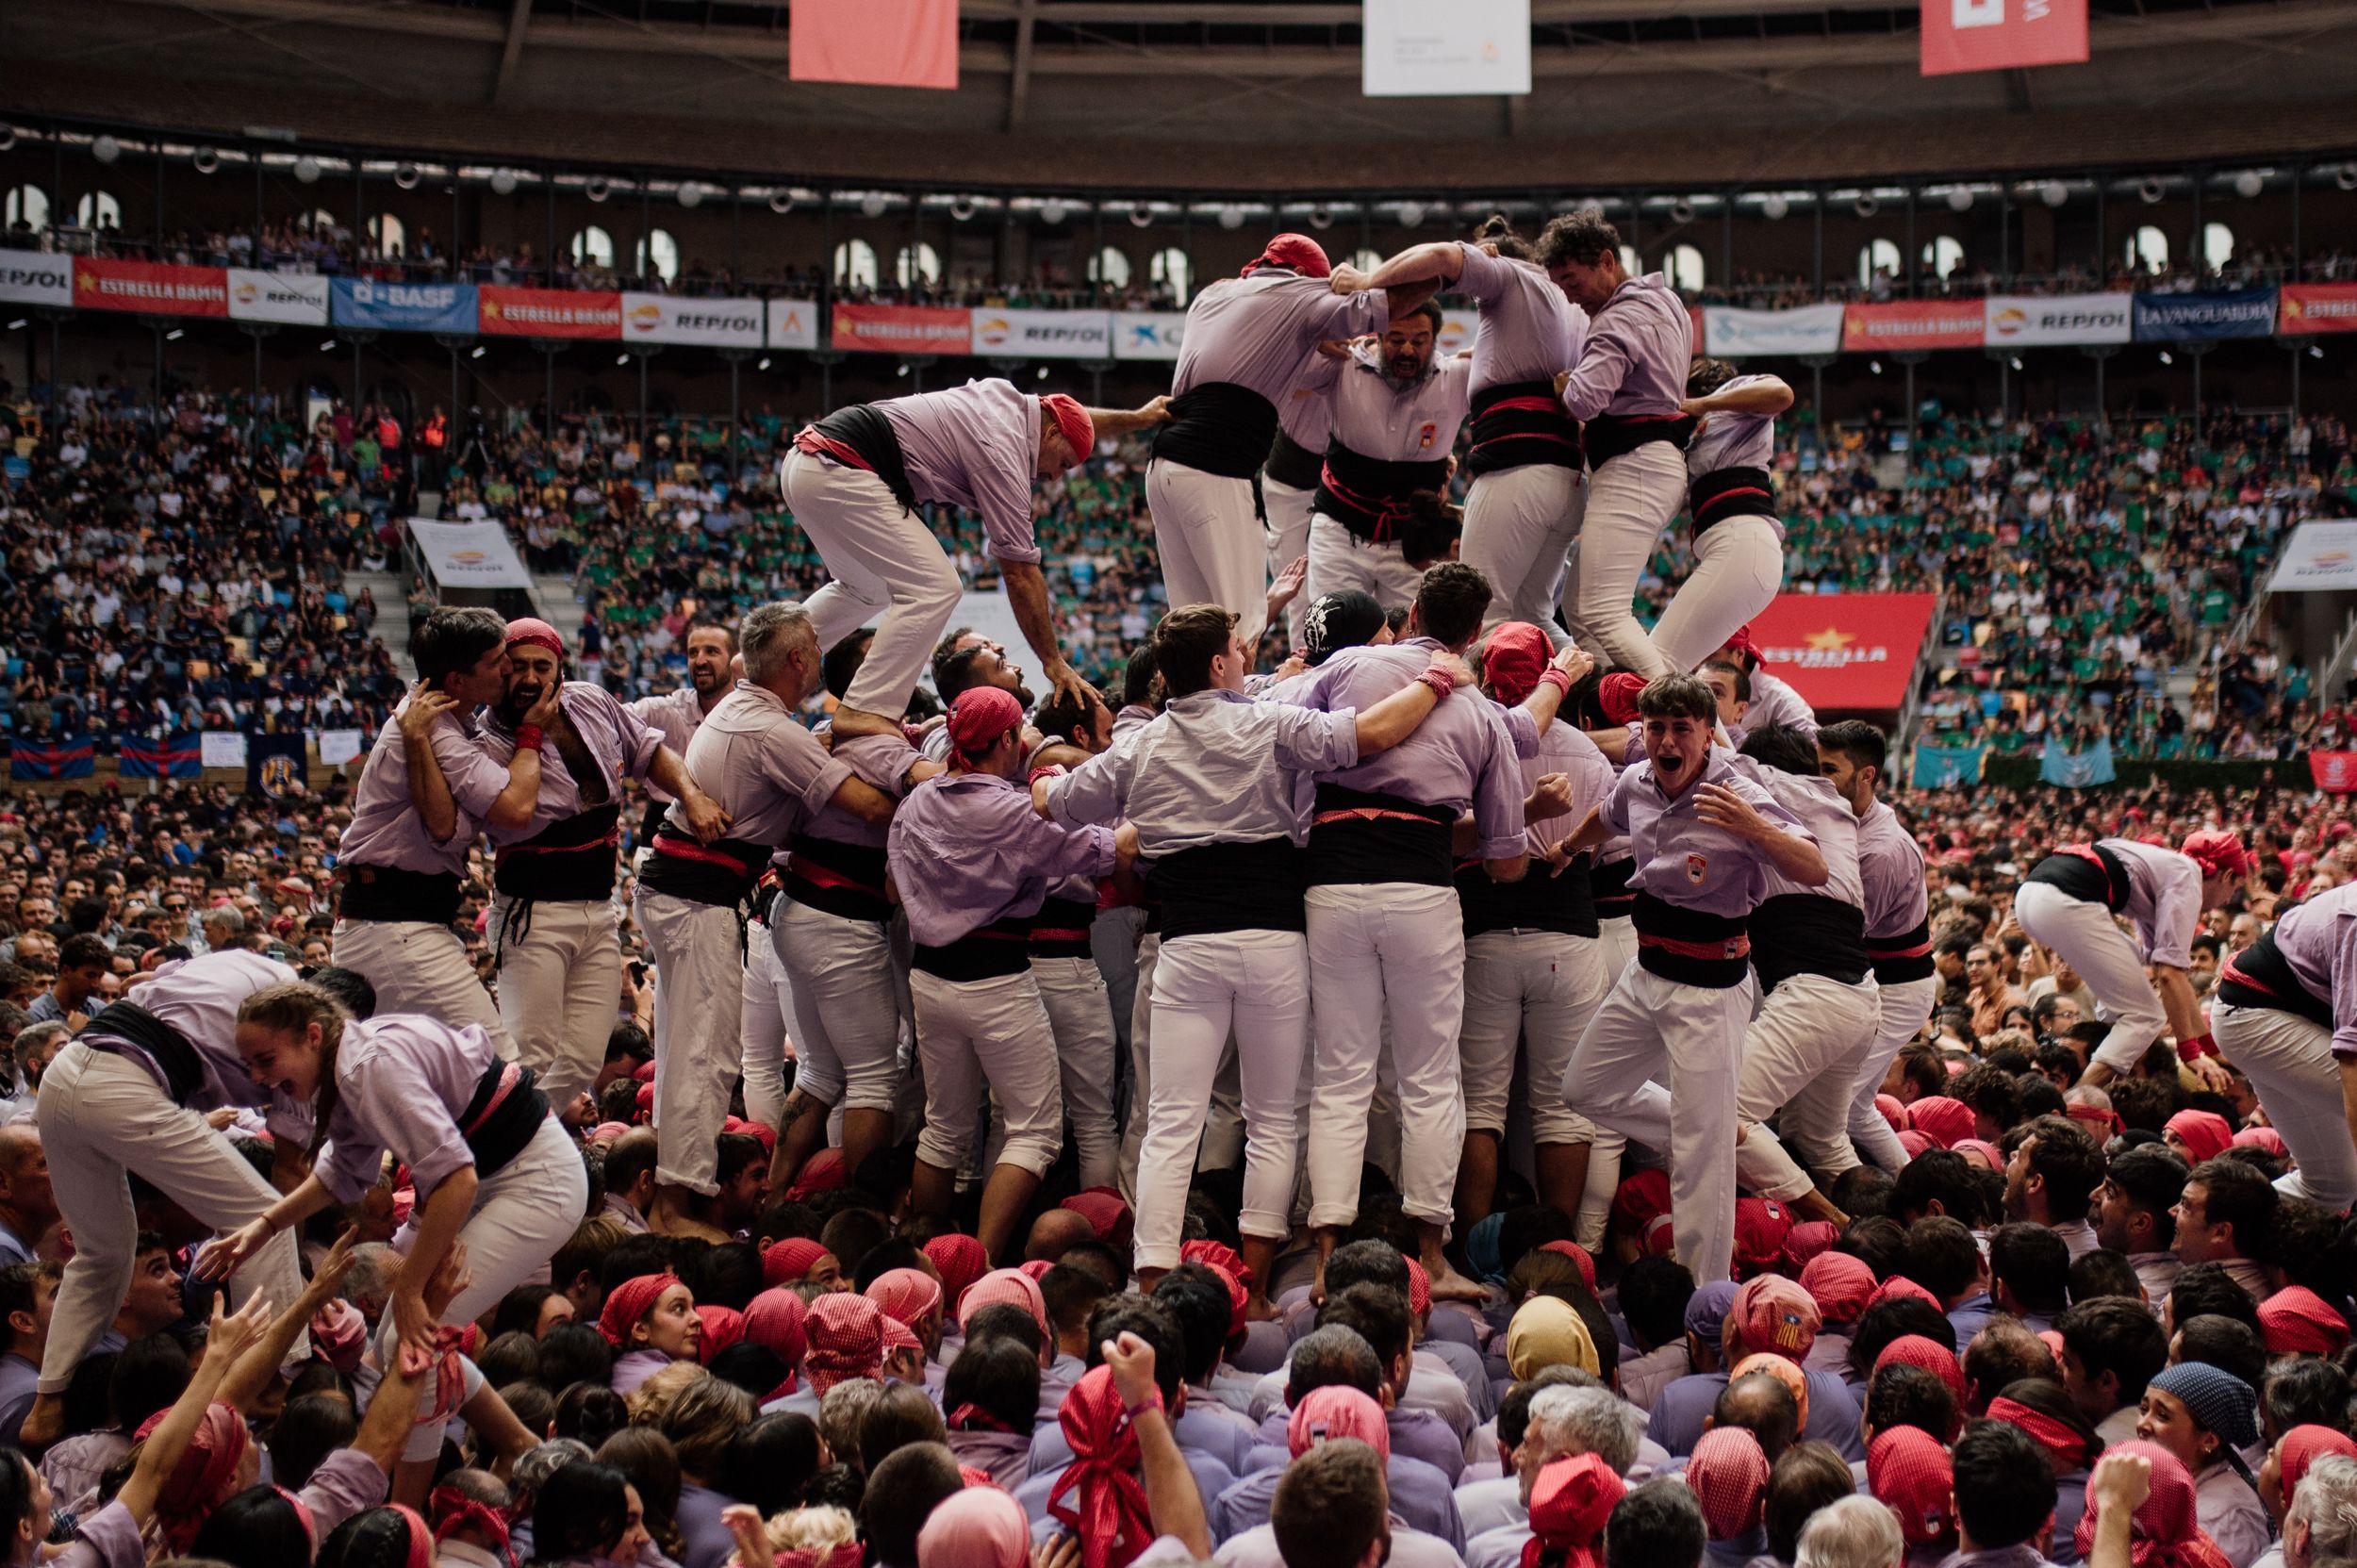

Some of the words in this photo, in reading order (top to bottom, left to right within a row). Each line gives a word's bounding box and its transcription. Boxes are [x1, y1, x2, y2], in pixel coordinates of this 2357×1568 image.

[100, 278, 174, 299] ESTRELLA
[387, 285, 454, 308] BASF
[503, 306, 573, 324] ESTRELLA
[677, 313, 756, 332] REPSOL
[2041, 314, 2125, 329] REPSOL
[1025, 327, 1102, 341] REPSOL
[1762, 646, 1887, 663] ESTRELLA
